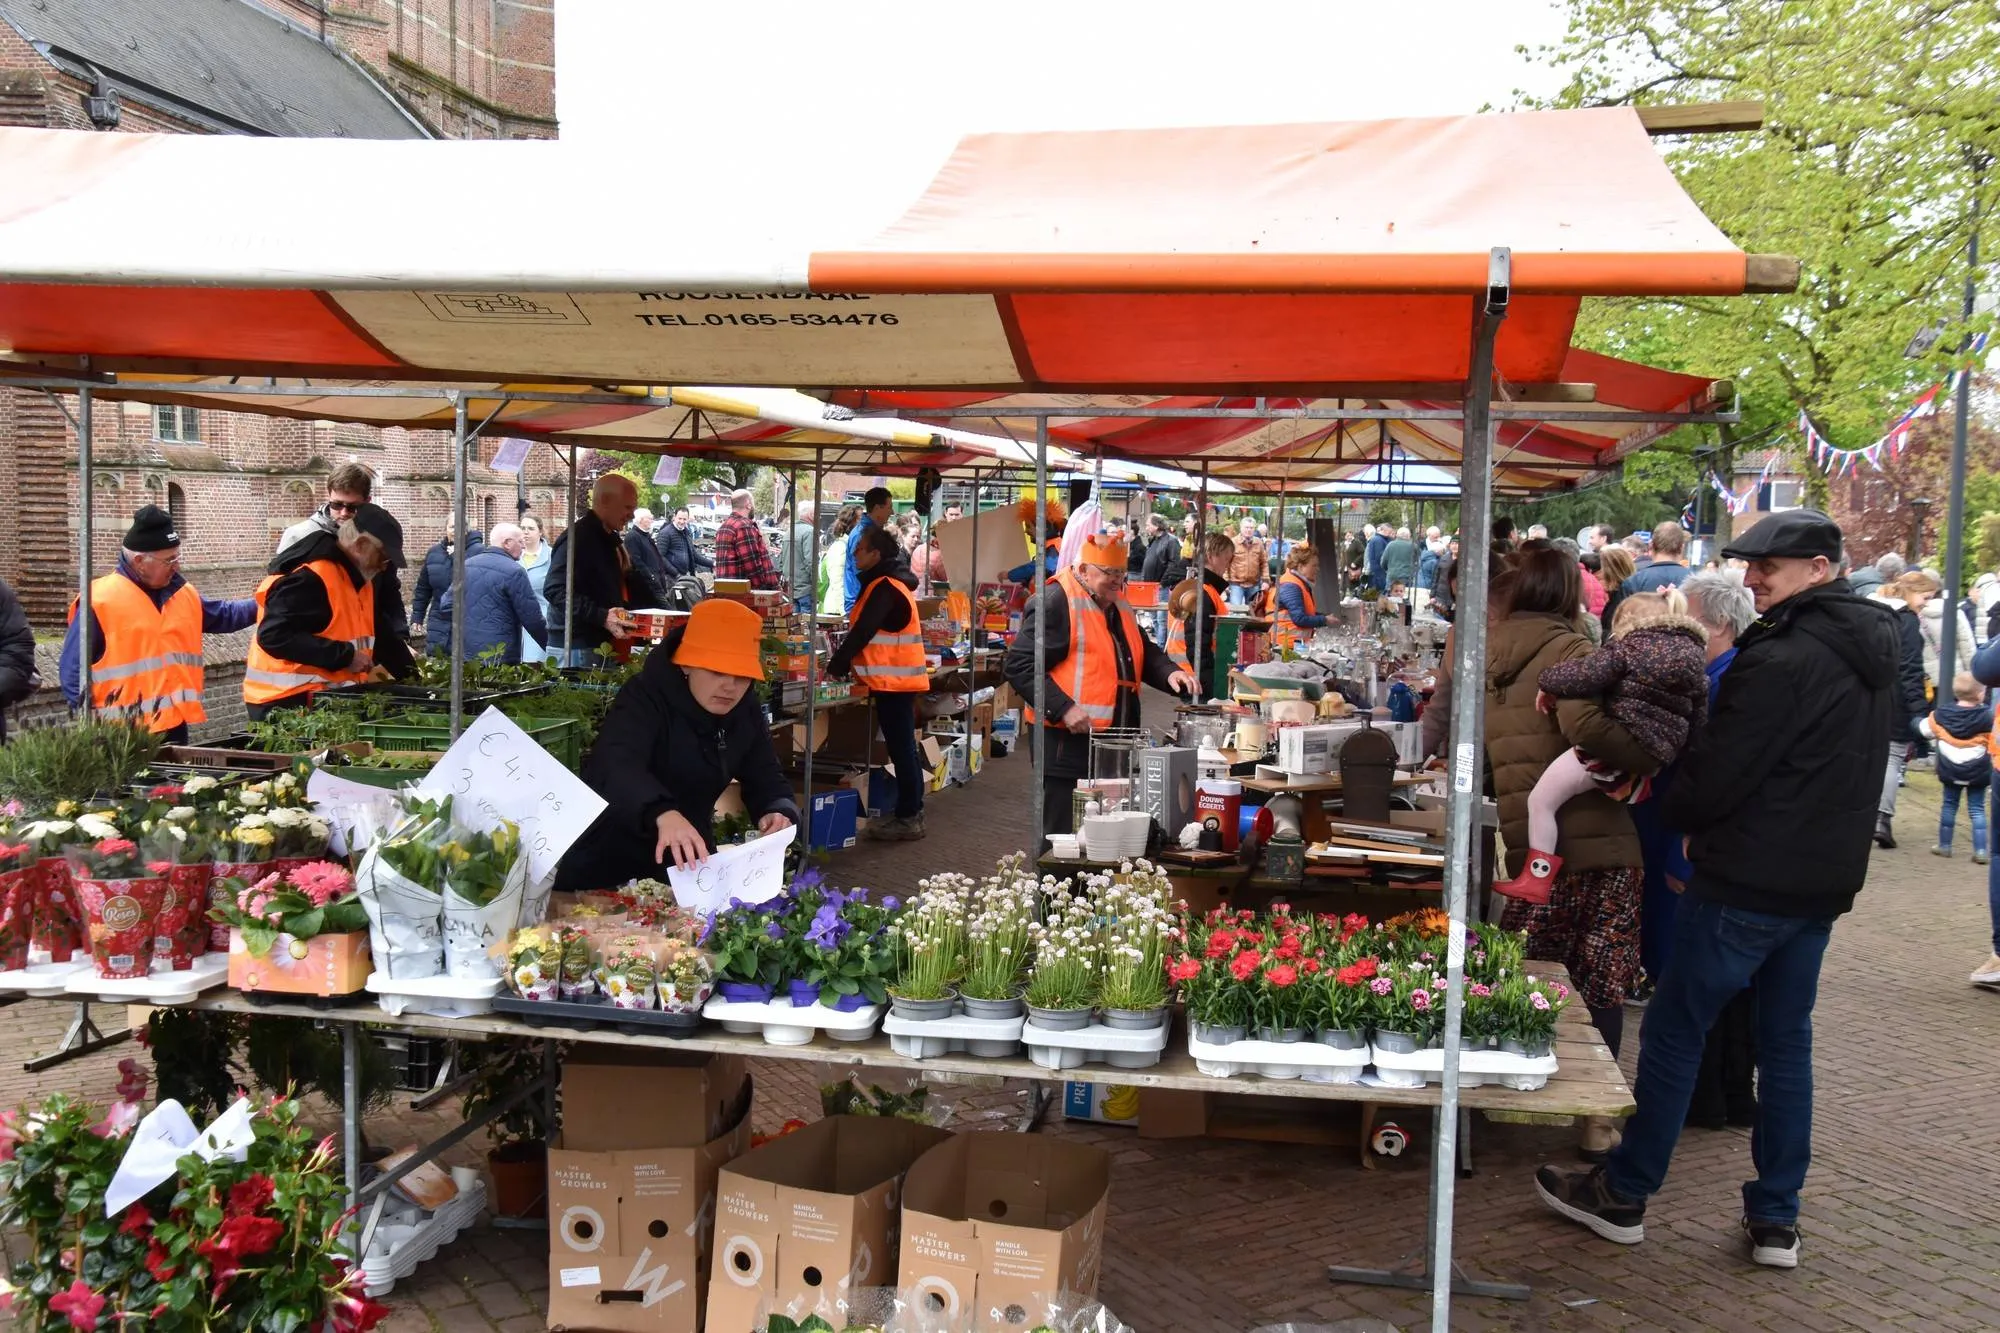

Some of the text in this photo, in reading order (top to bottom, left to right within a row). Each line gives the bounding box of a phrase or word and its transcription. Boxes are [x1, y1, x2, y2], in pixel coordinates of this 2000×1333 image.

[635, 313, 900, 326] TEL.0165-534476
[452, 768, 474, 794] 3
[555, 1169, 592, 1180] MASTER
[560, 1179, 607, 1189] GROWERS
[724, 1194, 756, 1210] MASTER
[727, 1205, 769, 1223] GROWERS
[911, 1234, 951, 1250] MASTER
[916, 1246, 967, 1262] GROWERS
